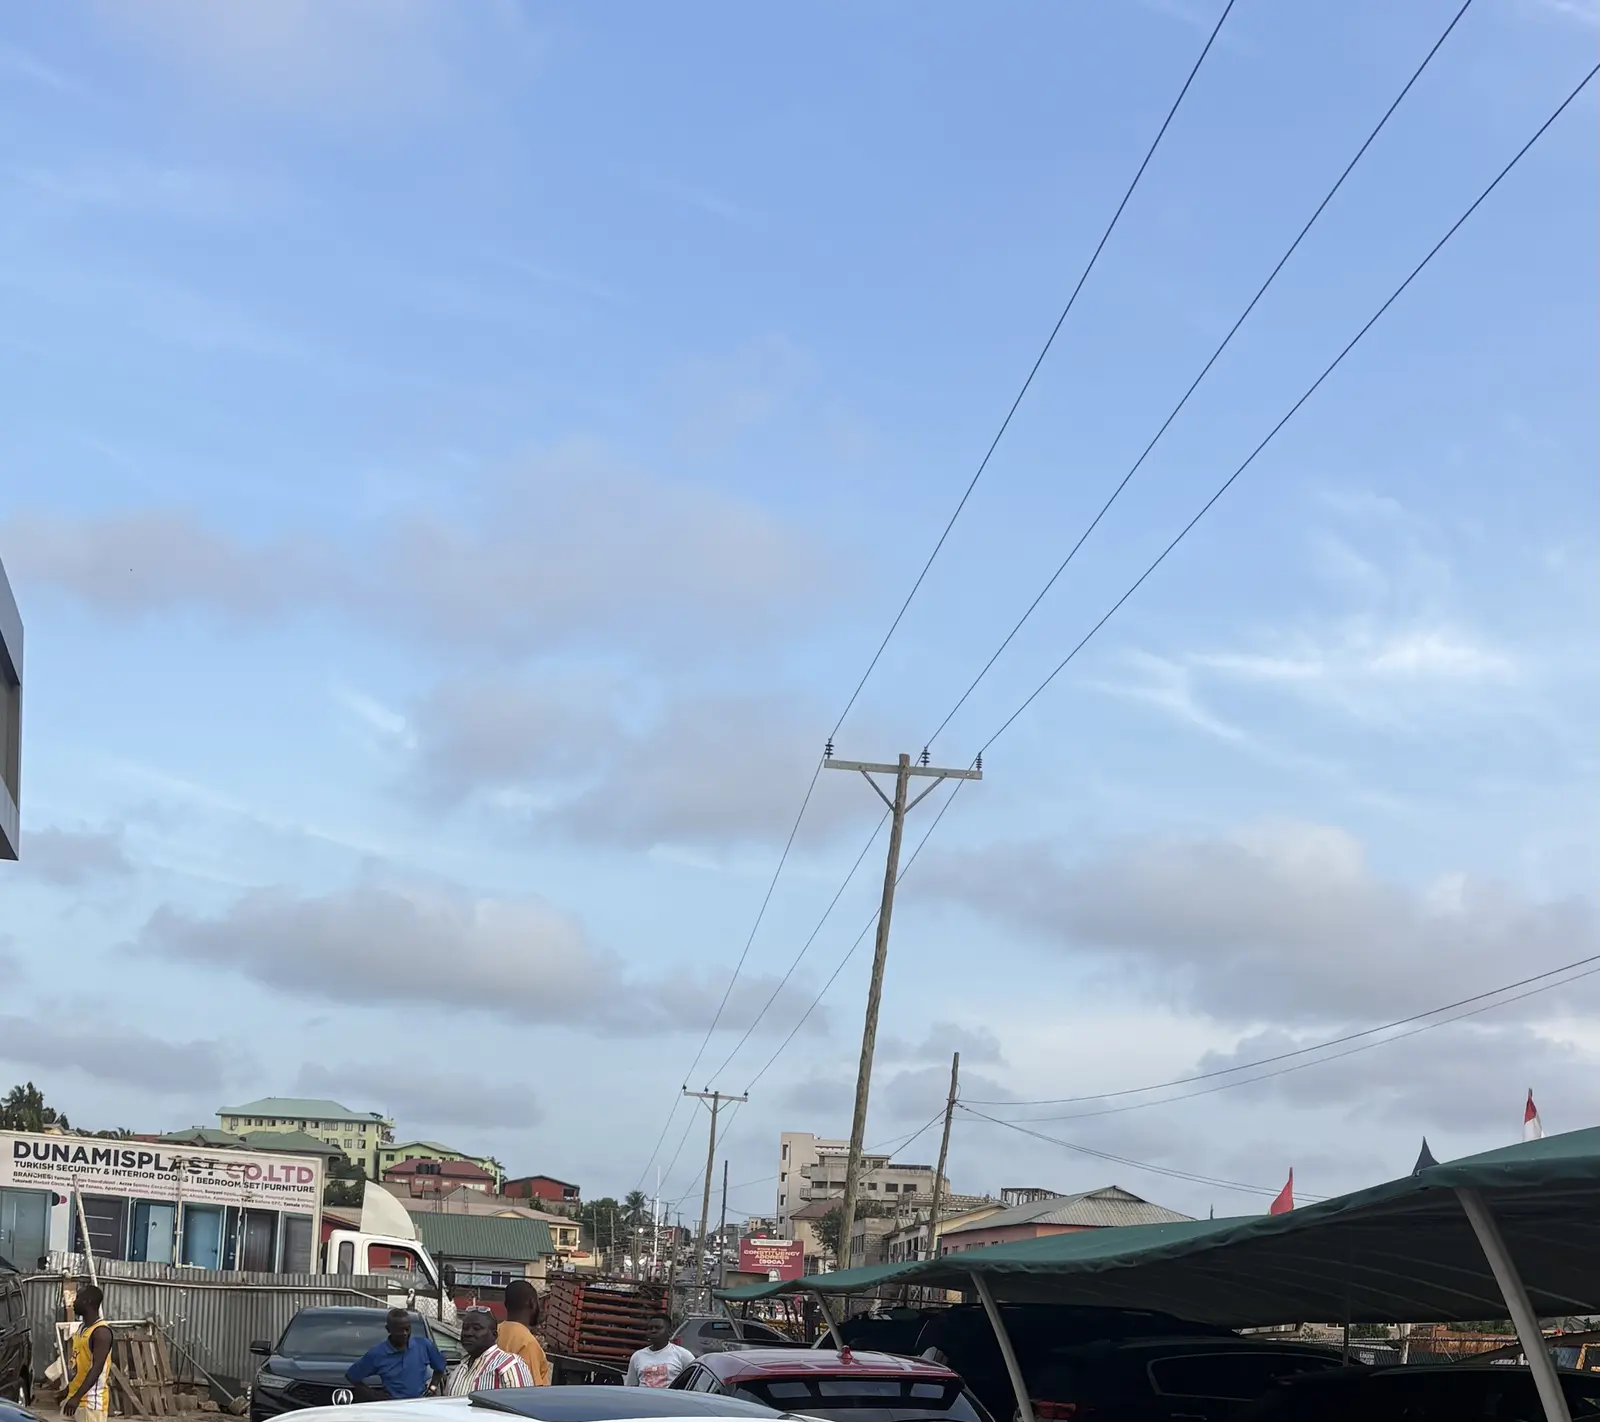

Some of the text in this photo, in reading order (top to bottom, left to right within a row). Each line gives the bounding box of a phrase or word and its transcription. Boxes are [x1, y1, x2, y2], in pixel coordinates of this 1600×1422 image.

[13, 1141, 314, 1184] DUNAMISPLAST CO.LTD
[14, 1160, 54, 1171] TURKISH
[56, 1164, 101, 1175] SECURITY
[112, 1168, 155, 1179] INTERIOR
[196, 1177, 241, 1188] BEDROOM
